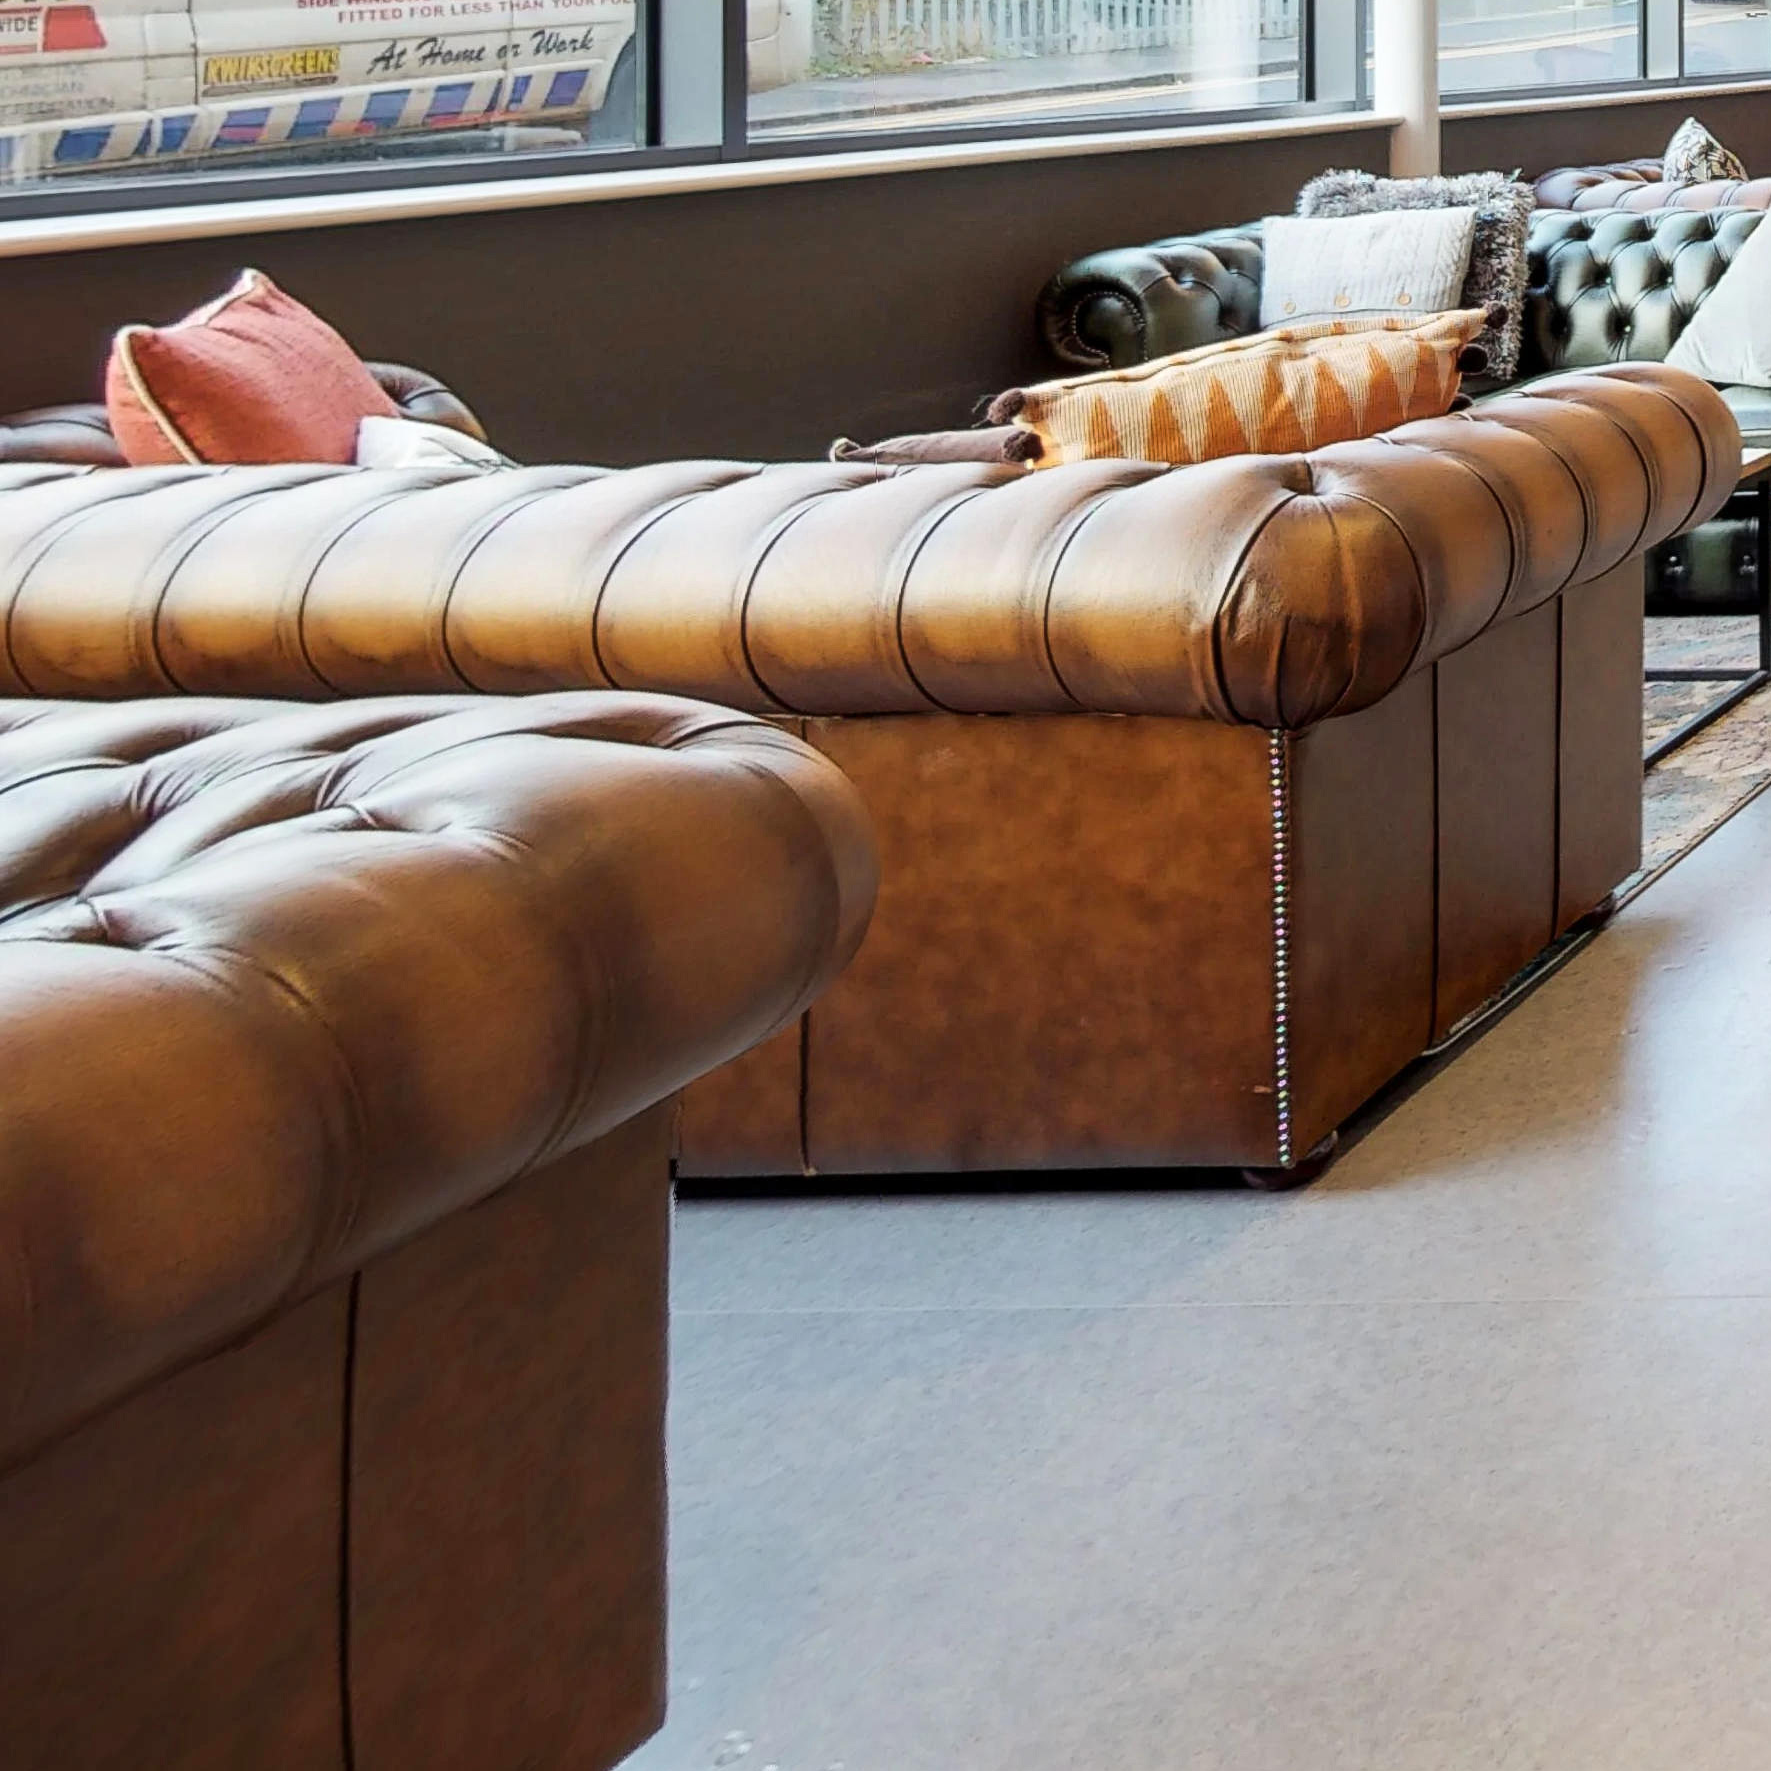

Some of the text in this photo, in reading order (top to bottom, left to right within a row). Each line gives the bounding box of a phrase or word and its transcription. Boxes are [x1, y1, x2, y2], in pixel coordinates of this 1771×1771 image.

[338, 8, 403, 24] FITTED
[409, 5, 446, 19] FOR
[451, 1, 493, 16] LESS
[366, 25, 595, 75] At Home or Work
